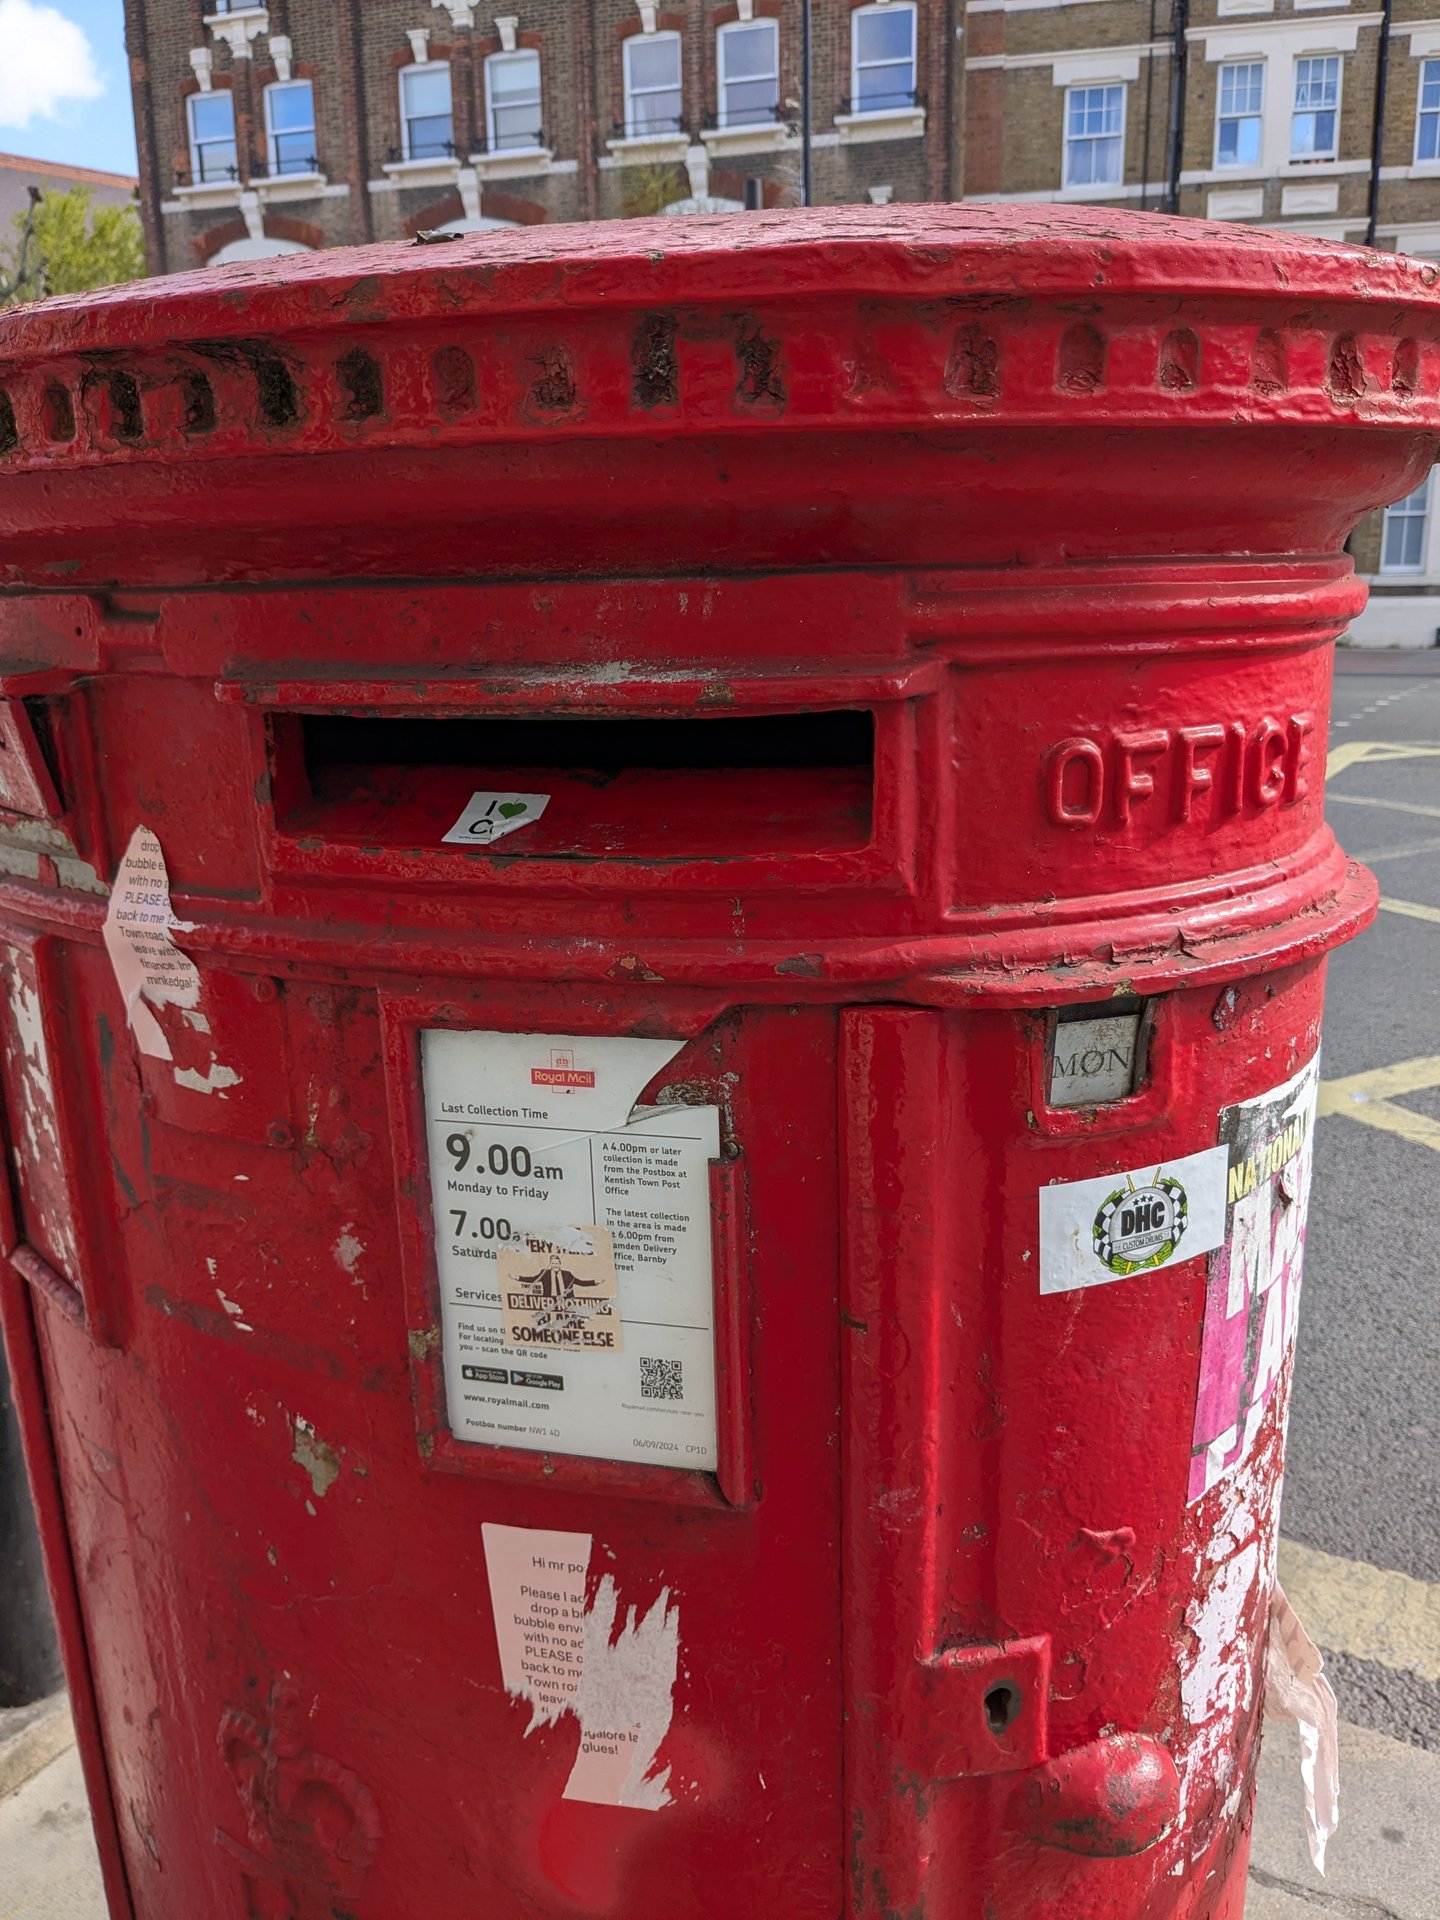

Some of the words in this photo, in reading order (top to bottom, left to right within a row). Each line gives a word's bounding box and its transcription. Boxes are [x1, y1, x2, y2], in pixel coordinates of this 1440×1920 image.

[1045, 713, 1313, 828] OFFICE
[484, 800, 498, 816] I
[141, 840, 160, 856] drop
[125, 857, 157, 870] bubble
[129, 874, 149, 888] with
[150, 878, 163, 890] no
[124, 890, 163, 907] PLEASE
[116, 908, 138, 921] back
[140, 912, 149, 923] to
[150, 914, 165, 925] me
[118, 925, 144, 938] Town
[145, 931, 165, 942] road
[131, 943, 157, 956] leave
[140, 958, 178, 971] finance.
[146, 975, 195, 991] minkedgal
[1052, 1046, 1132, 1079] MON
[534, 1070, 566, 1084] Royal
[567, 1072, 592, 1084] Mail
[441, 1102, 464, 1114] Last
[467, 1104, 518, 1118] Collection
[521, 1107, 549, 1120] Time
[446, 1133, 564, 1180] 9.00am
[602, 1142, 609, 1151] A
[610, 1142, 647, 1154] 4.00pm
[661, 1147, 682, 1156] later
[603, 1154, 643, 1165] collection
[645, 1156, 653, 1165] is
[655, 1158, 678, 1167] made
[603, 1165, 624, 1174] from
[626, 1167, 640, 1175] the
[642, 1168, 676, 1178] Postbox
[678, 1171, 687, 1179] at
[447, 1179, 493, 1197] Monday
[496, 1185, 508, 1195] to
[512, 1185, 549, 1200] Friday
[604, 1175, 635, 1186] Kentish
[638, 1178, 659, 1187] Town
[662, 1180, 681, 1189] Post
[605, 1186, 630, 1196] Office
[606, 1207, 622, 1217] The
[624, 1208, 648, 1219] latest
[650, 1210, 690, 1222] collection
[1120, 1200, 1166, 1238] DHC
[606, 1218, 614, 1227] in
[617, 1219, 631, 1228] the
[633, 1221, 652, 1230] area
[654, 1222, 662, 1231] is
[664, 1223, 687, 1233] made
[618, 1230, 652, 1242] 6.00pm
[654, 1233, 675, 1243] from
[1122, 1236, 1145, 1251] CUSTOM
[1145, 1232, 1164, 1245] DRUMS
[451, 1244, 498, 1260] Saturda
[612, 1242, 641, 1252] amden
[643, 1243, 678, 1255] Delivery
[614, 1252, 635, 1261] ffice,
[637, 1253, 667, 1264] Barnby
[614, 1262, 635, 1272] treet
[455, 1286, 502, 1302] Services
[458, 1322, 475, 1331] Find
[488, 1326, 498, 1334] on
[458, 1333, 471, 1341] For
[473, 1334, 504, 1346] locating
[512, 1325, 580, 1346] SOMEONE
[582, 1330, 615, 1348] ELSE
[459, 1344, 474, 1352] you
[482, 1345, 499, 1354] scan
[501, 1346, 514, 1356] the
[516, 1348, 528, 1357] QR
[530, 1350, 548, 1359] code
[463, 1393, 550, 1411] www.royalmail.com
[465, 1417, 496, 1429] Postbox
[497, 1422, 527, 1433] number
[529, 1425, 547, 1436] NW1
[632, 1438, 679, 1452] 06/09/2024
[532, 1556, 546, 1568] Hi
[548, 1561, 565, 1571] mr
[567, 1563, 584, 1574] po
[520, 1585, 561, 1601] Please
[530, 1602, 559, 1618] drop
[513, 1613, 555, 1631] bubble
[523, 1631, 549, 1644] with
[552, 1636, 567, 1647] no
[525, 1645, 573, 1663] PLEASE
[521, 1659, 550, 1674] back
[552, 1664, 565, 1676] to
[525, 1674, 560, 1690] Town
[539, 1692, 566, 1704] leav
[581, 1741, 619, 1755] glues!
